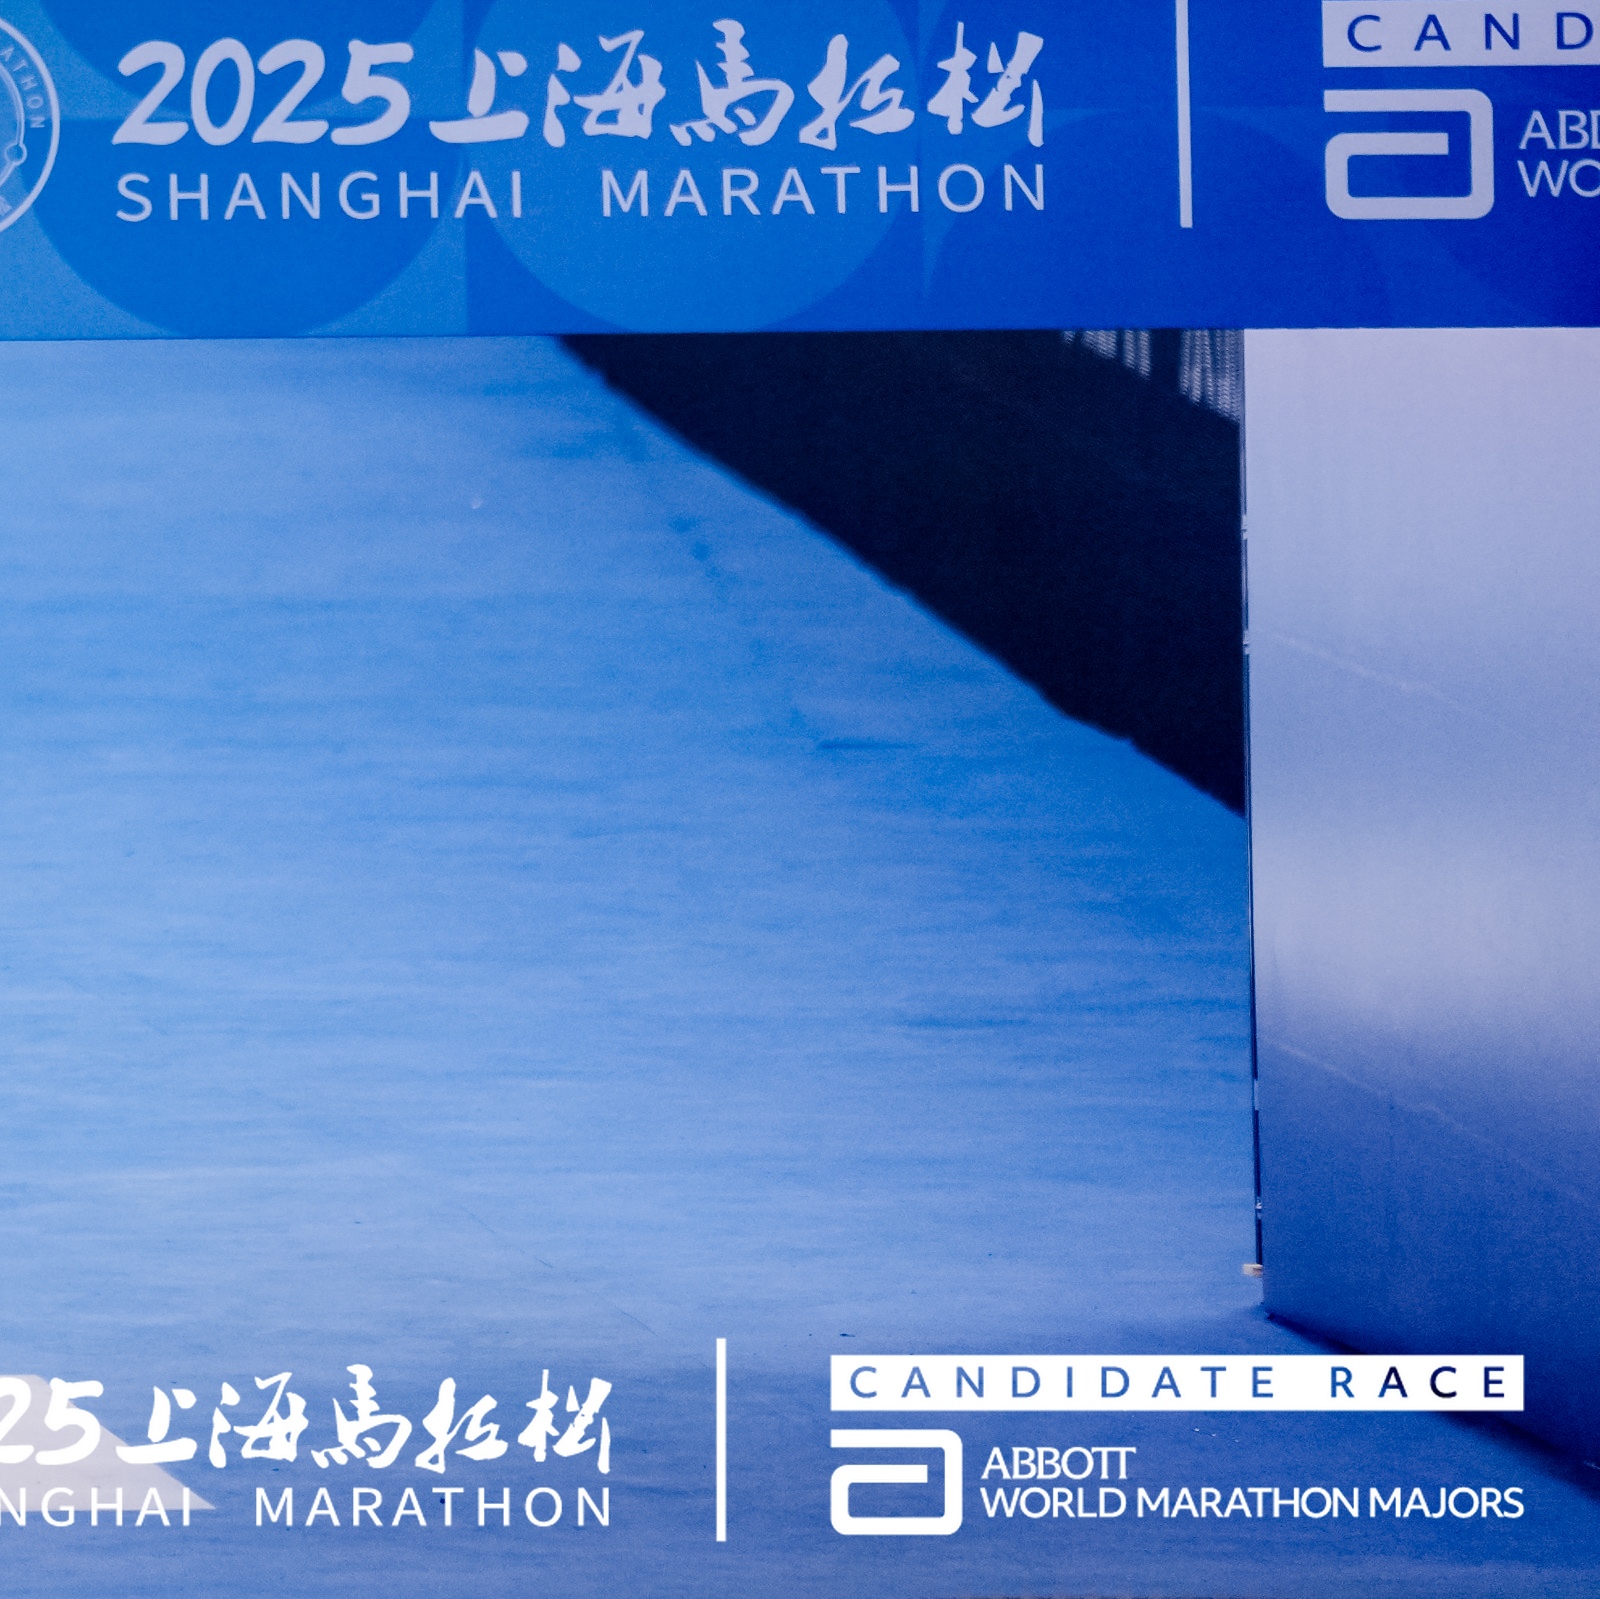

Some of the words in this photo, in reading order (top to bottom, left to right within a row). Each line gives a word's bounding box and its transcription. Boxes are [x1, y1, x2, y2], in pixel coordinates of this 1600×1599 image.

[1347, 12, 1595, 53] CAND
[1518, 110, 1600, 150] AB
[115, 170, 523, 223] SHANGHAI
[602, 163, 1045, 218] MARATHON
